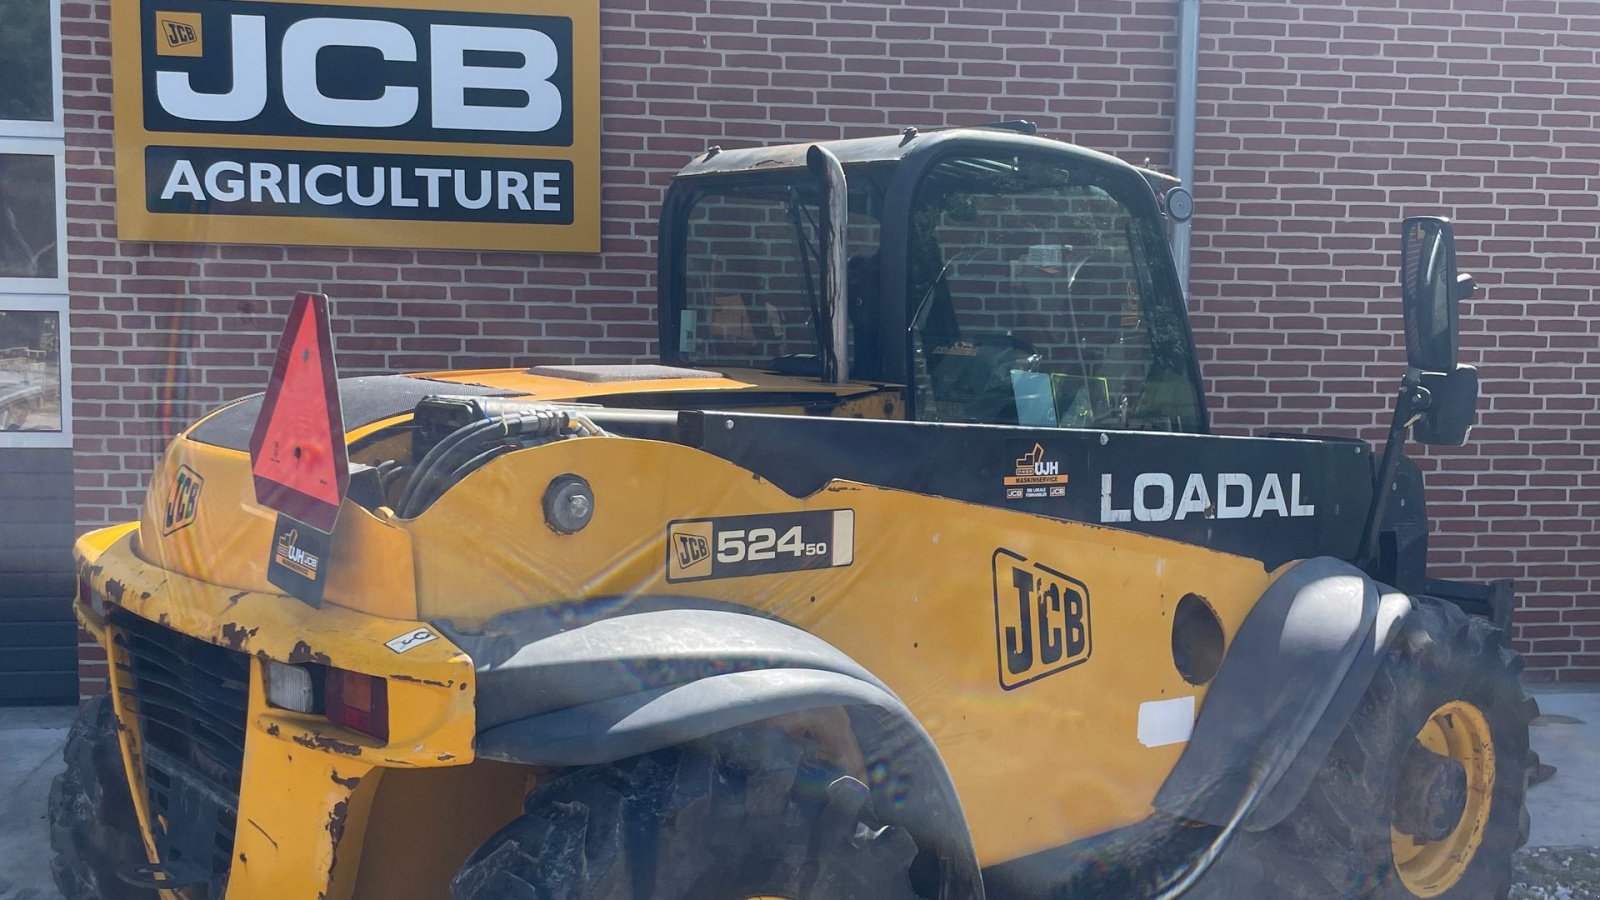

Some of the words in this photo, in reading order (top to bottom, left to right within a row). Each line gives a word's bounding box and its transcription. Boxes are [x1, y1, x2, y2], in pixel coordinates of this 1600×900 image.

[168, 23, 195, 44] JCB
[156, 14, 562, 132] JCB
[160, 159, 562, 211] AGRICULTURE
[1015, 476, 1058, 484] MASKINSERVICE
[1034, 461, 1059, 475] UJH
[166, 472, 200, 528] JCB
[1100, 473, 1315, 523] LOADAL
[679, 536, 708, 566] JCB
[716, 525, 804, 564] 524
[806, 542, 828, 556] 50
[1005, 566, 1086, 675] JCB
